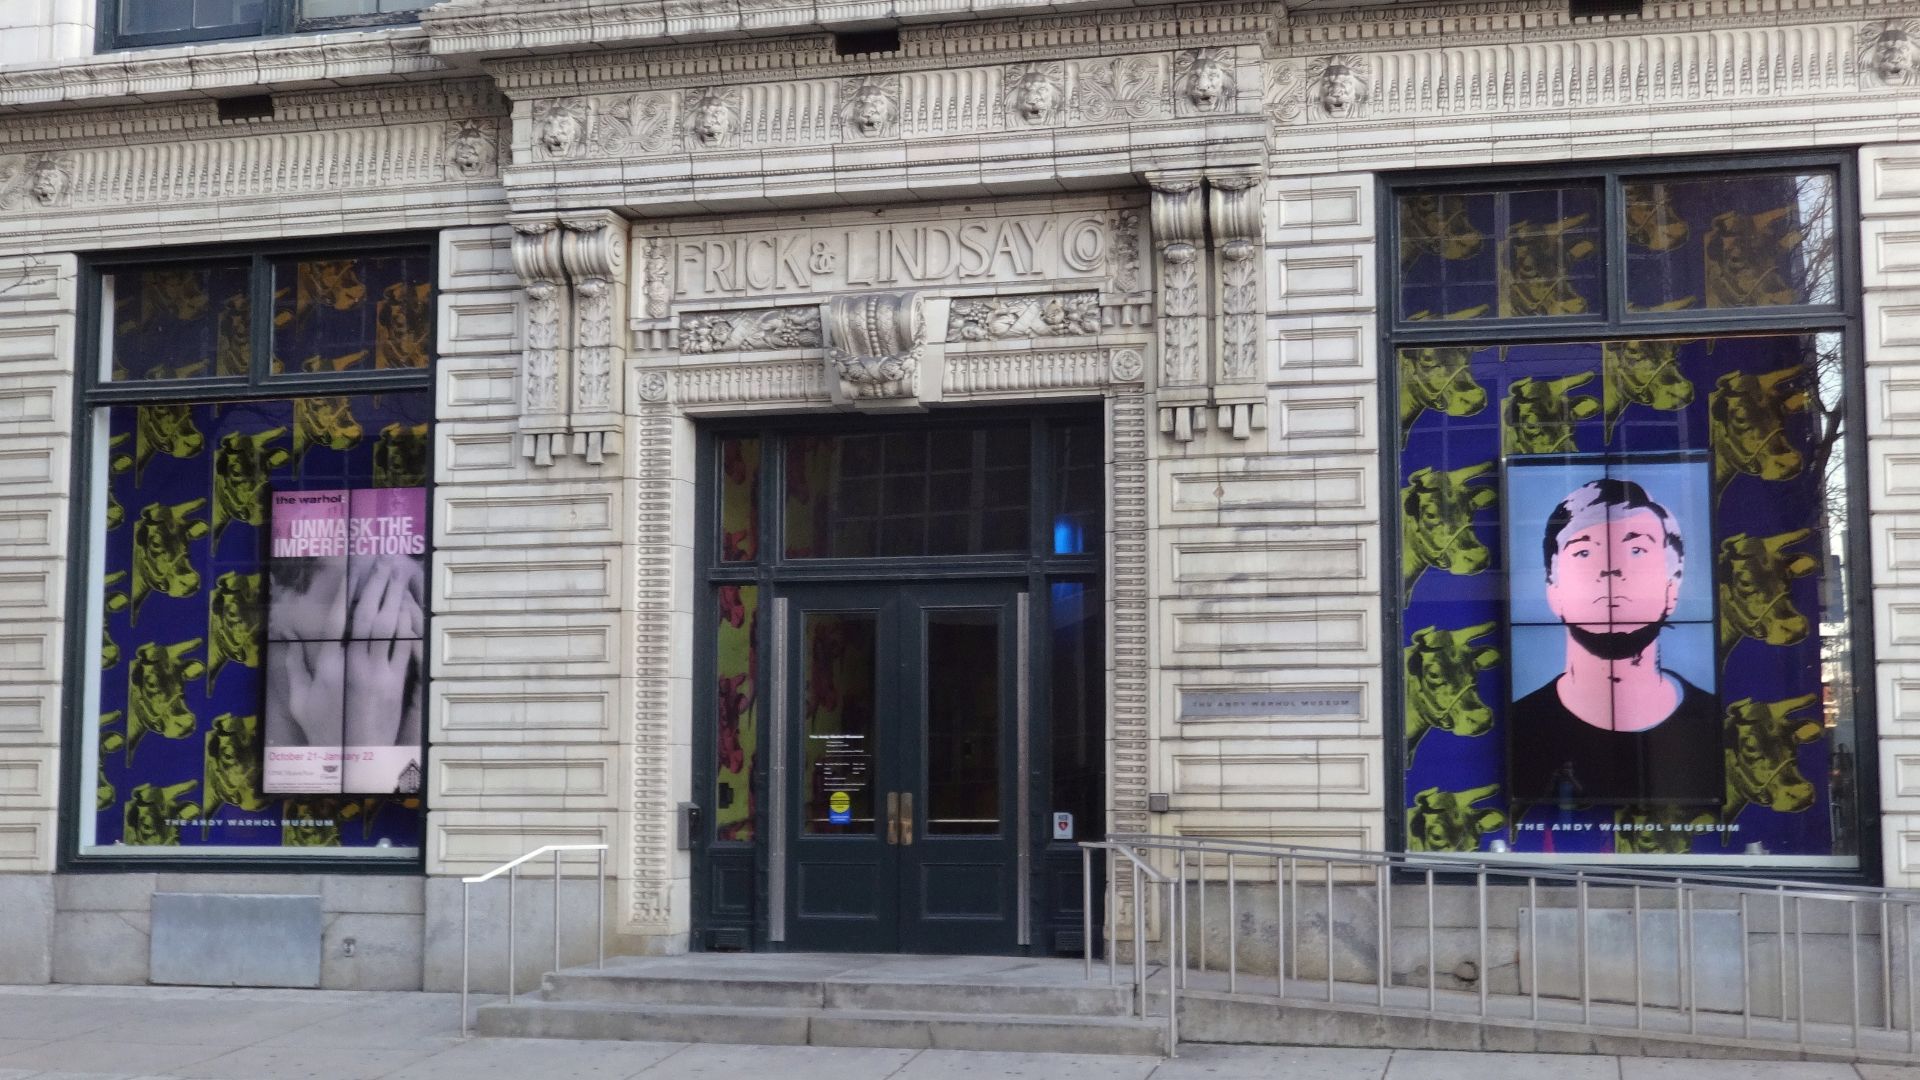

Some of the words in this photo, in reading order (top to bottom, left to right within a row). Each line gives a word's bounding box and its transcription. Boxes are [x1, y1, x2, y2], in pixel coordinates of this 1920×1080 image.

[675, 235, 809, 294] FRICK
[845, 220, 1055, 286] LINDSAY
[275, 496, 296, 505] the
[291, 517, 373, 539] UNMASK
[376, 516, 414, 536] THE
[274, 534, 425, 558] IMPERFECTIONS
[269, 752, 304, 761] October
[362, 751, 375, 761] 22
[1515, 823, 1545, 831] THE
[1551, 823, 1593, 831] ANDY
[1599, 823, 1664, 832] WARHOL
[1670, 823, 1740, 832] MUSEUM
